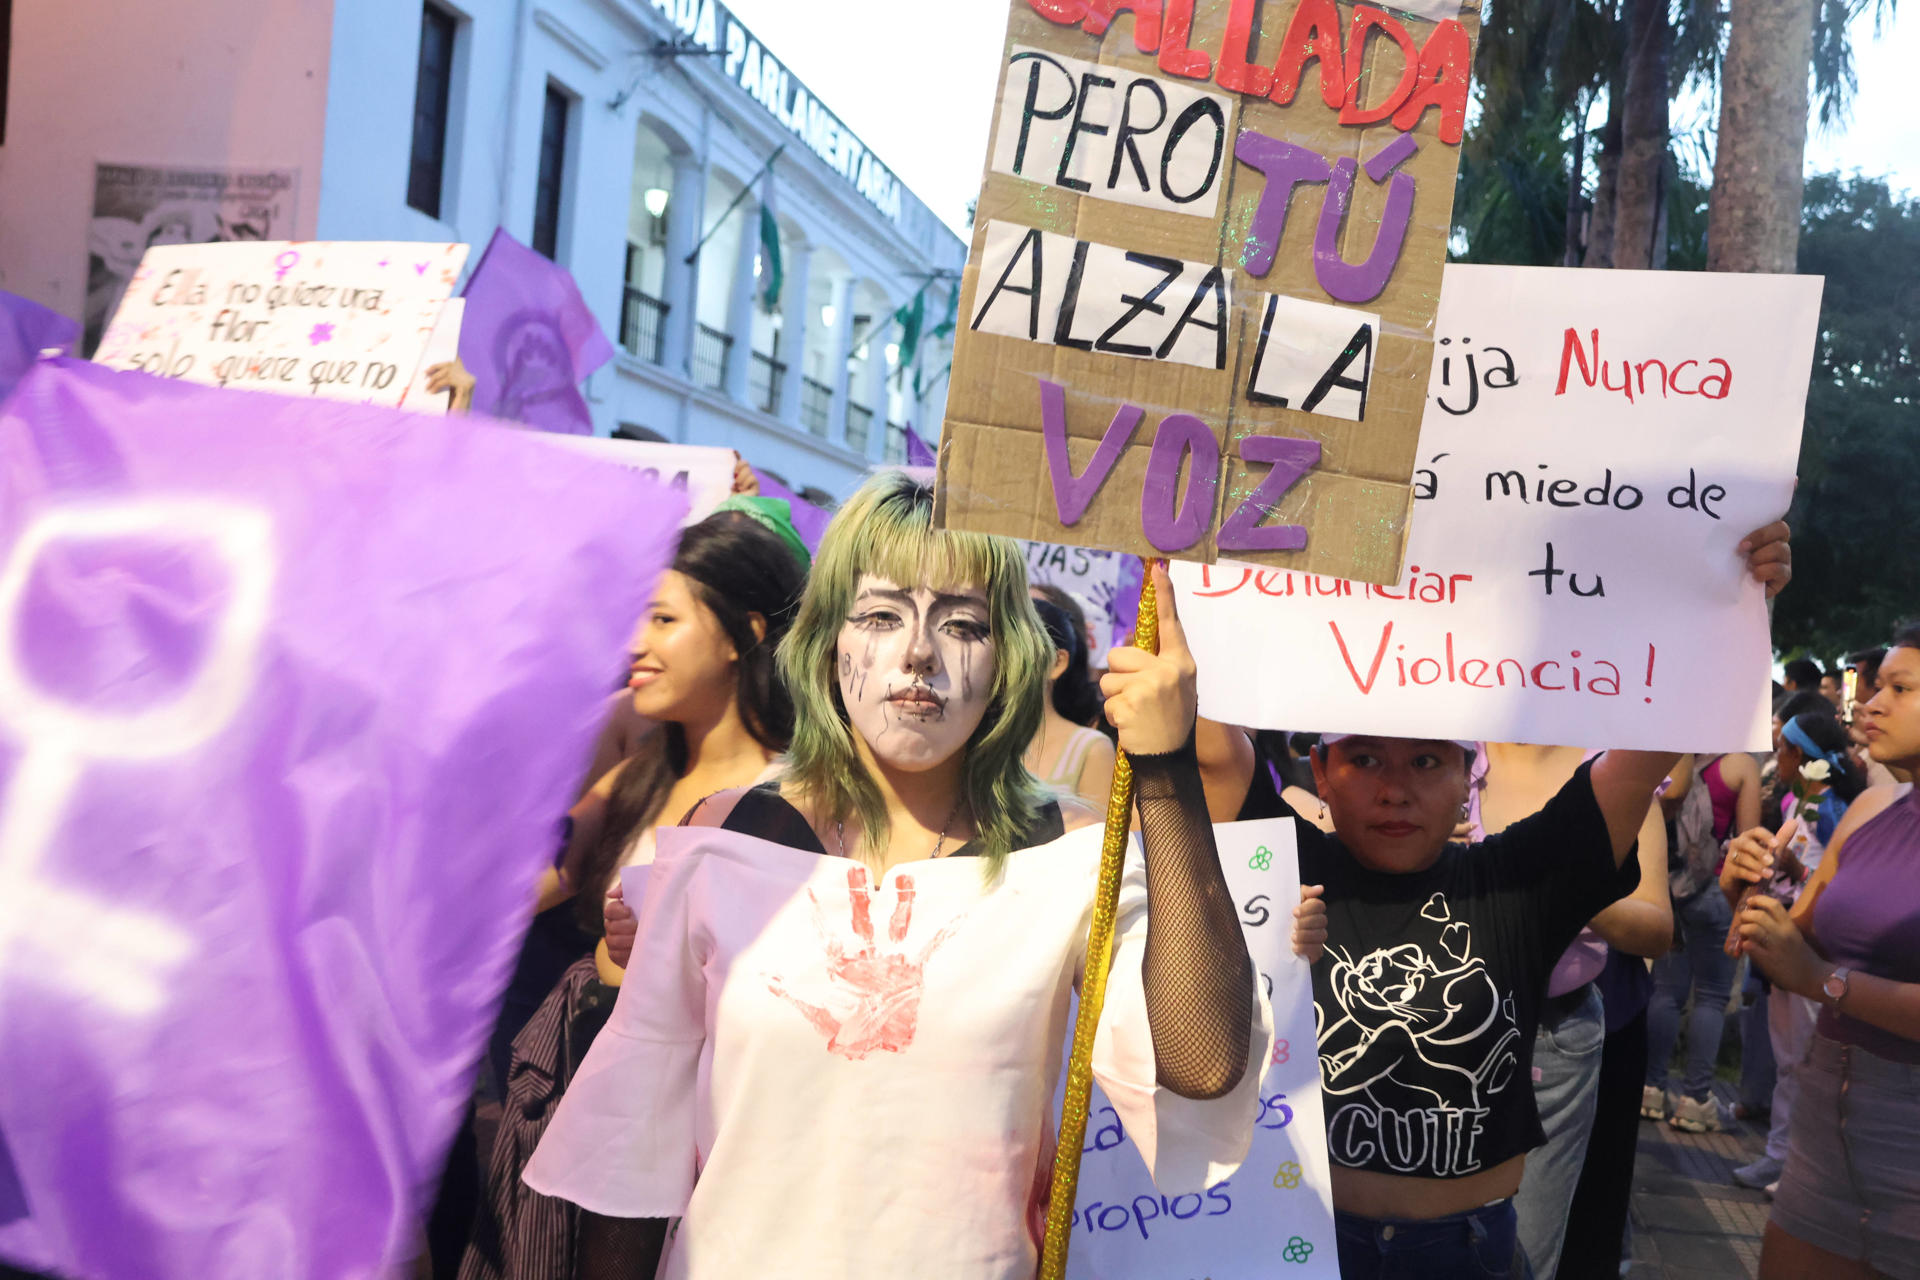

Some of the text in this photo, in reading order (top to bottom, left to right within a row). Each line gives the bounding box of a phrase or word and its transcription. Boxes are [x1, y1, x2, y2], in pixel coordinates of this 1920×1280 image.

[1028, 0, 1470, 144] ALLADA
[1009, 51, 1418, 302] PERO TÚ
[153, 268, 208, 307] Ella
[227, 283, 261, 305] no
[209, 309, 269, 342] flor
[970, 229, 1372, 421] ALZA LA
[129, 340, 398, 394] solo quiere que no
[1555, 328, 1733, 404] Nunca
[1039, 379, 1321, 552] VOZ
[1486, 464, 1643, 511] miedo
[1668, 468, 1727, 519] de
[1528, 542, 1605, 597] tu
[1328, 1103, 1491, 1177] CUTE
